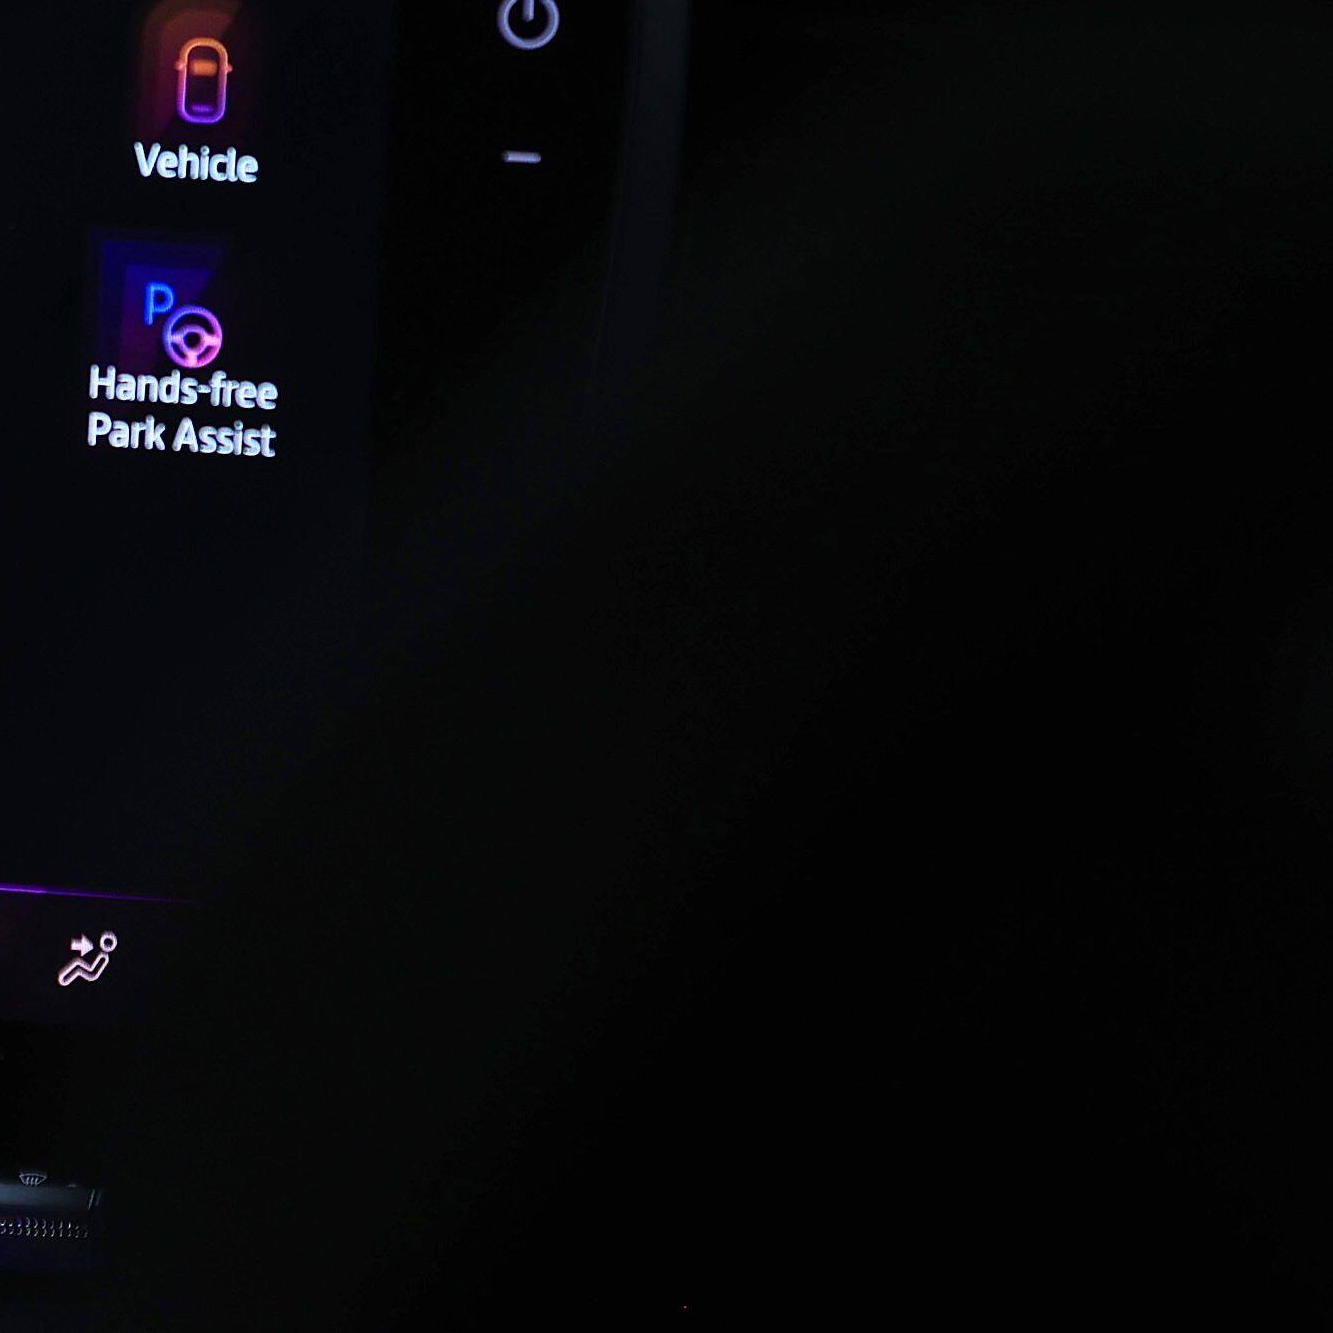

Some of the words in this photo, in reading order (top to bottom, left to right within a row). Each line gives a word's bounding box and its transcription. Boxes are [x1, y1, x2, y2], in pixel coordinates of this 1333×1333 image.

[133, 141, 260, 185] Vehicle
[88, 364, 279, 411] Hands-free
[87, 411, 166, 452] Park
[172, 416, 277, 459] Assist
